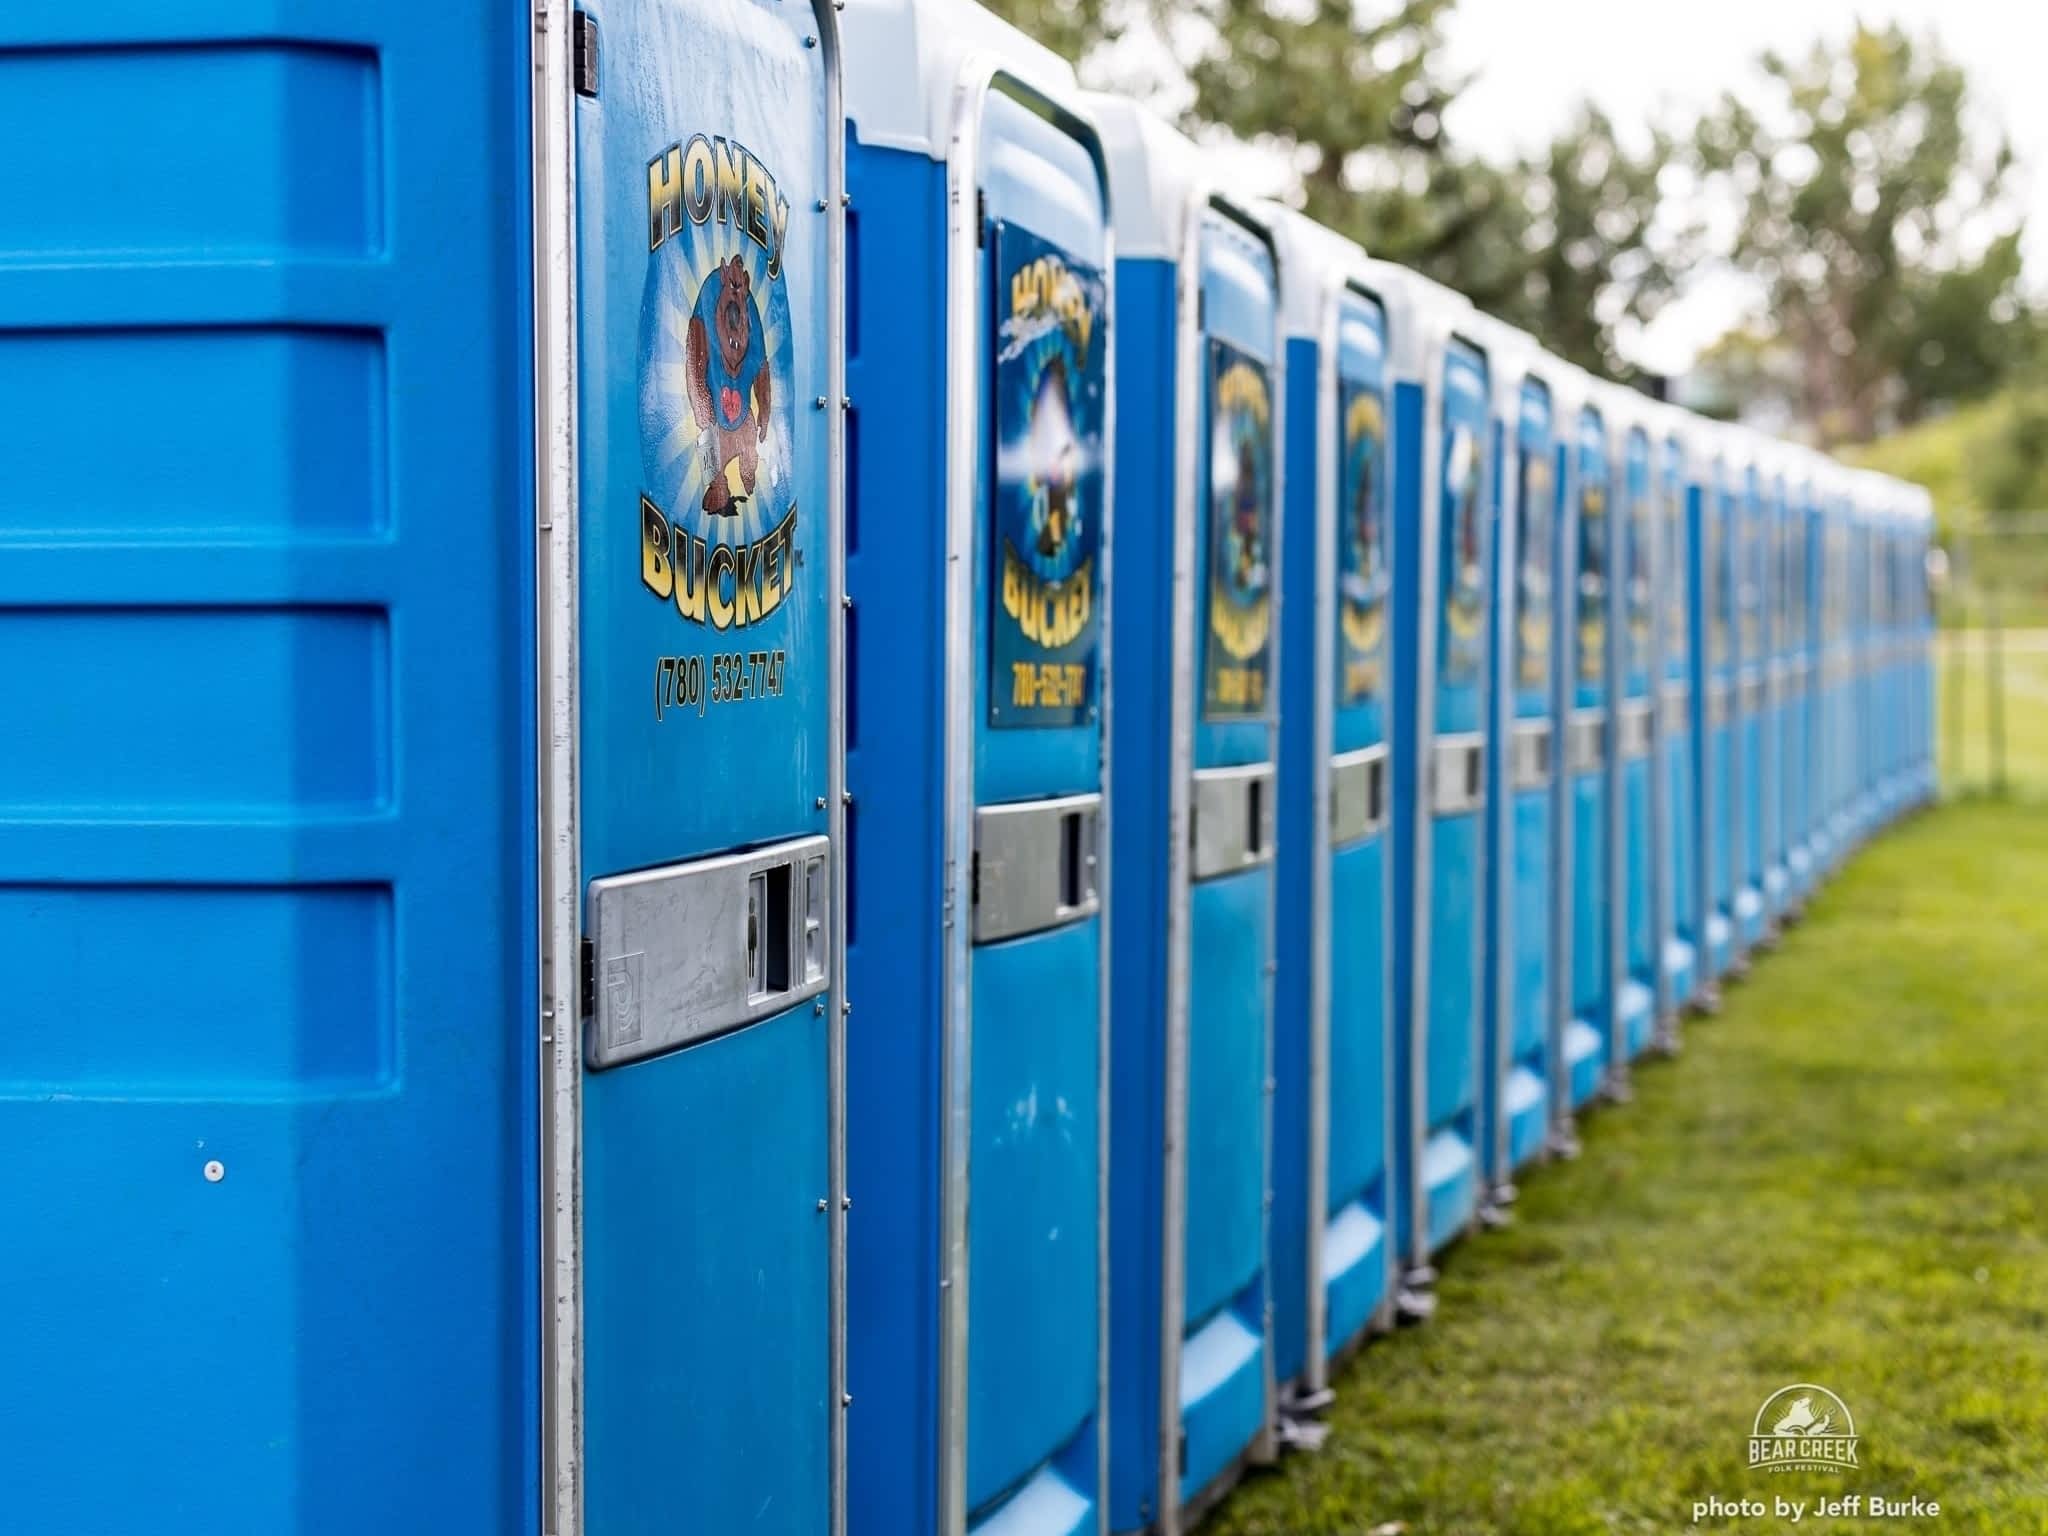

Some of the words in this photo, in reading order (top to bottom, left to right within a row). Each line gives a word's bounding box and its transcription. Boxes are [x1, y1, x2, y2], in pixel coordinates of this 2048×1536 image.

[647, 133, 790, 281] HONEY
[641, 491, 798, 632] BUCKET
[656, 654, 706, 722] (780)
[711, 651, 786, 703] 532-7747
